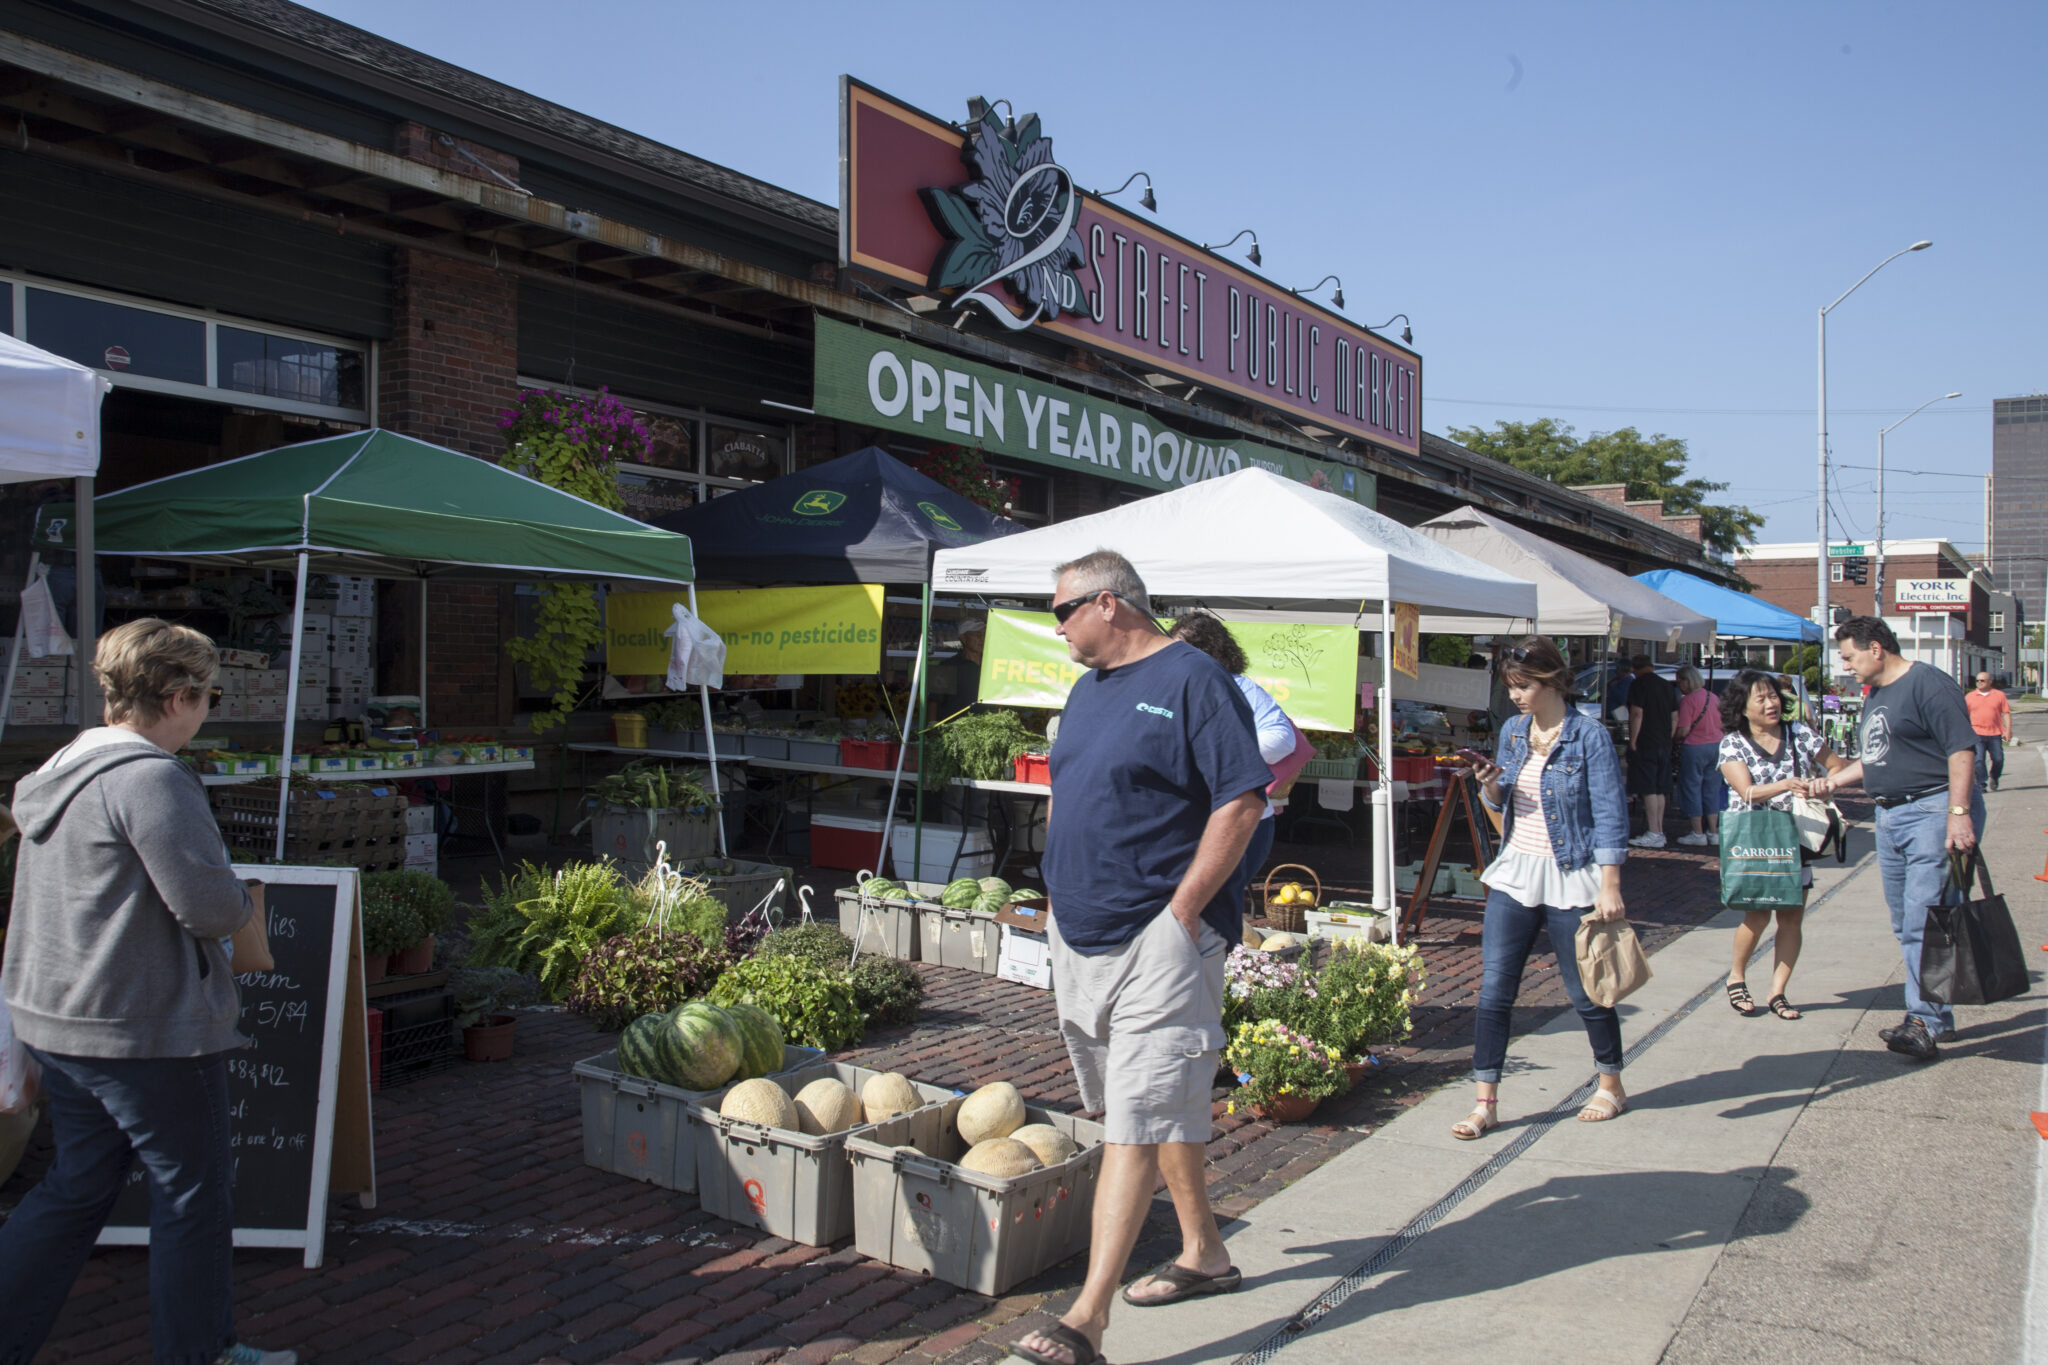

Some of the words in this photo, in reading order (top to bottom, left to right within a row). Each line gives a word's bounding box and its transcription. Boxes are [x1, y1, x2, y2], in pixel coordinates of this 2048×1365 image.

[1091, 224, 1207, 361] STREET
[1230, 286, 1319, 403] PUBLIC
[1337, 338, 1415, 440] MARKET
[868, 349, 1004, 443] OPEN
[1016, 388, 1120, 471] YEAR
[724, 440, 766, 461] CIABATTA
[945, 575, 990, 583] COUNTRYSIDE
[1910, 582, 1955, 591] YORK
[1948, 593, 1967, 601] Inc.
[611, 627, 670, 652] locally
[779, 621, 878, 652] pesticides
[991, 658, 1079, 687] FRESH
[268, 905, 297, 938] lies
[233, 971, 301, 990] arm
